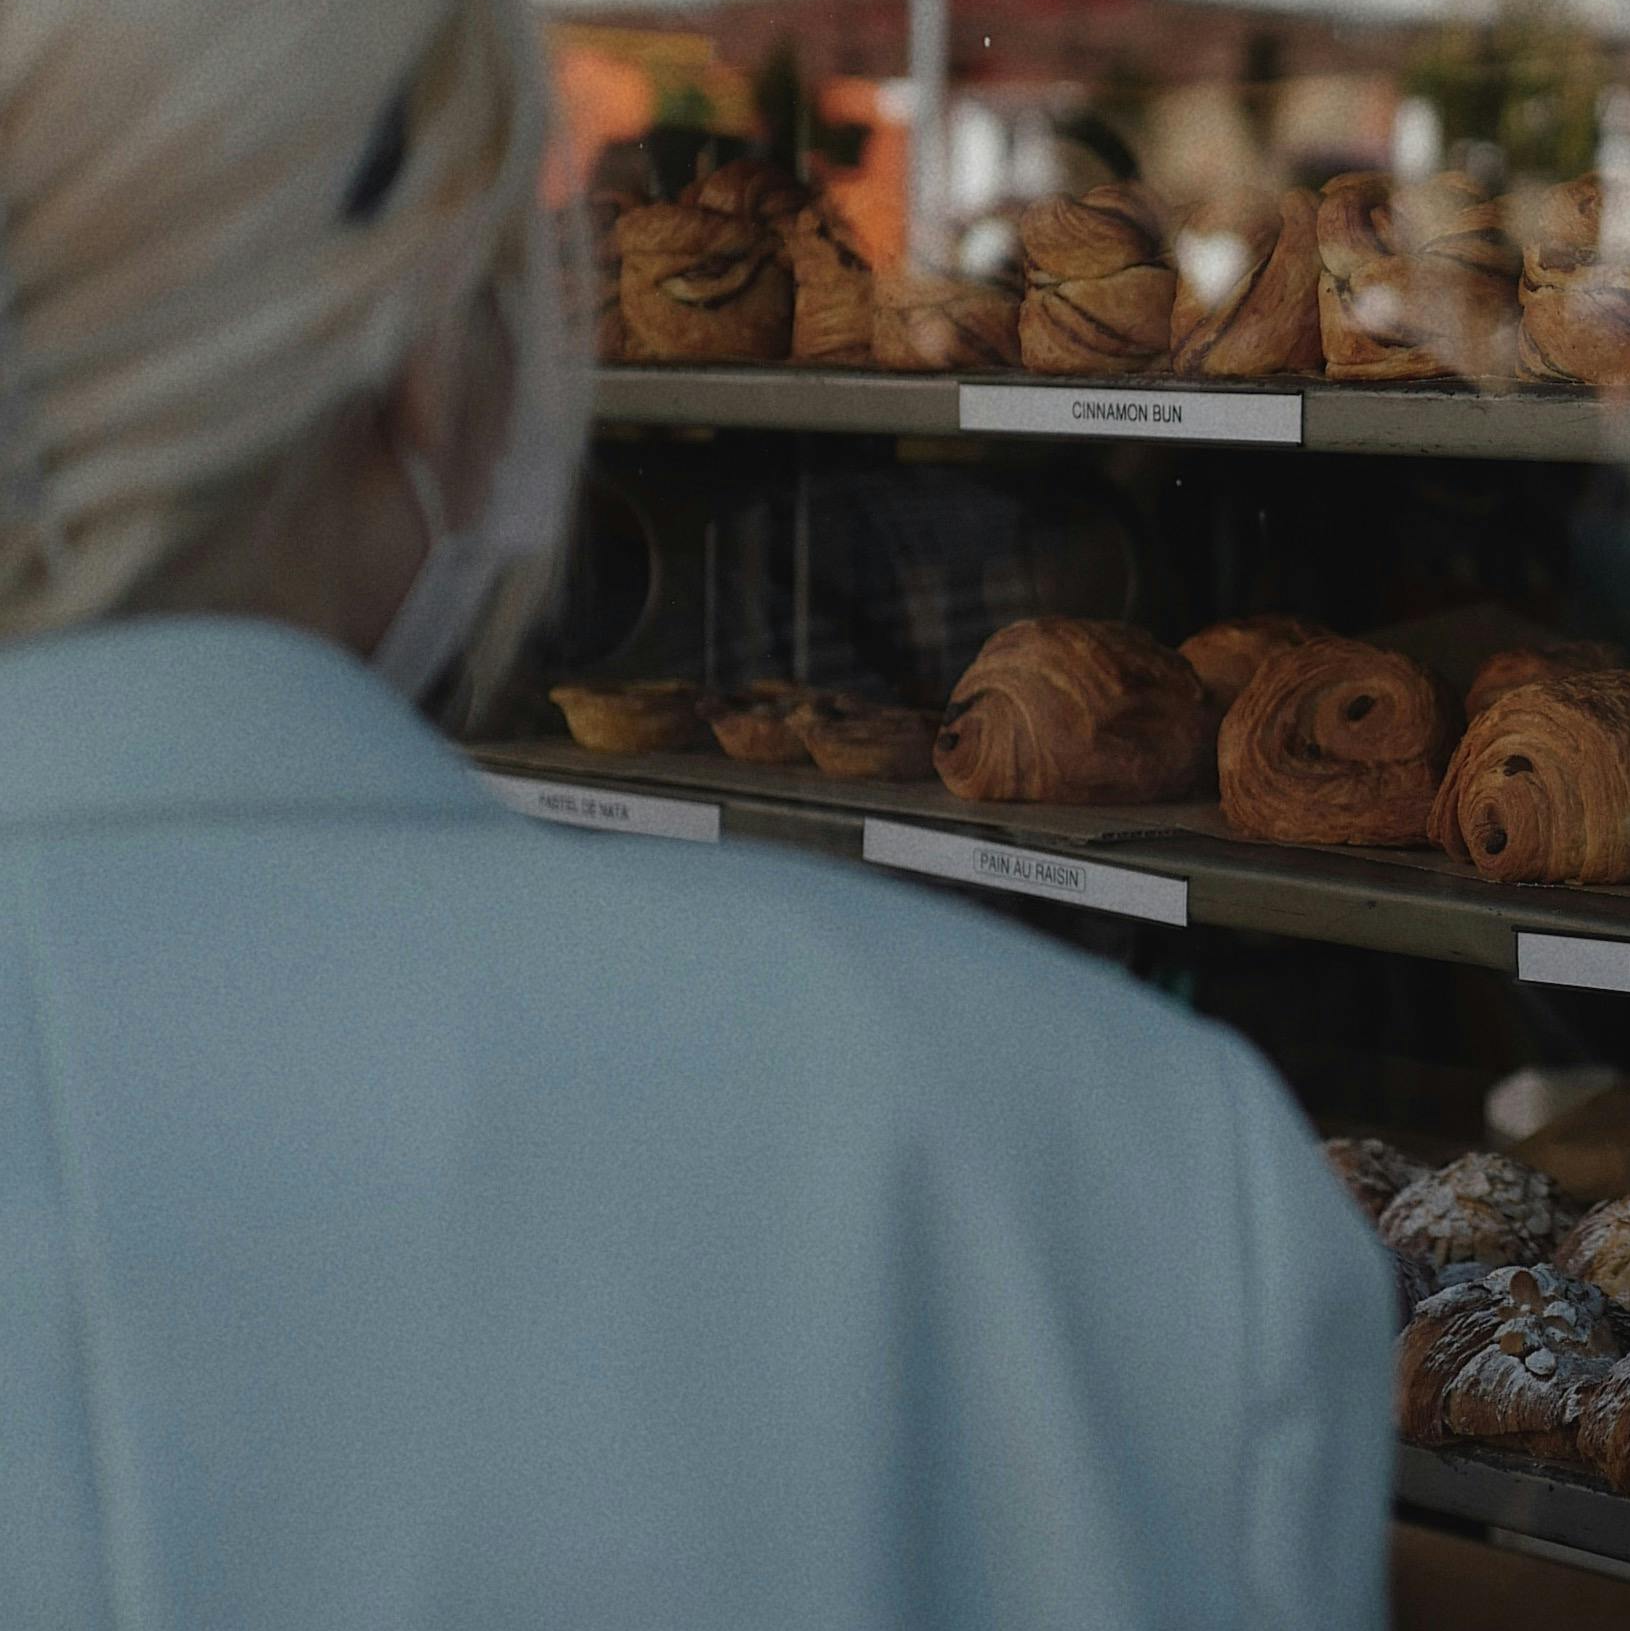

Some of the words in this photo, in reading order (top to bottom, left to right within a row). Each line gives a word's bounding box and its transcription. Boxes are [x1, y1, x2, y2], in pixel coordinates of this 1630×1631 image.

[1071, 400, 1149, 422] CINNAMON
[1152, 403, 1183, 424] BUN
[979, 851, 1010, 875] PAIN
[1013, 857, 1033, 879] AU
[1035, 862, 1080, 888] RAISIN
